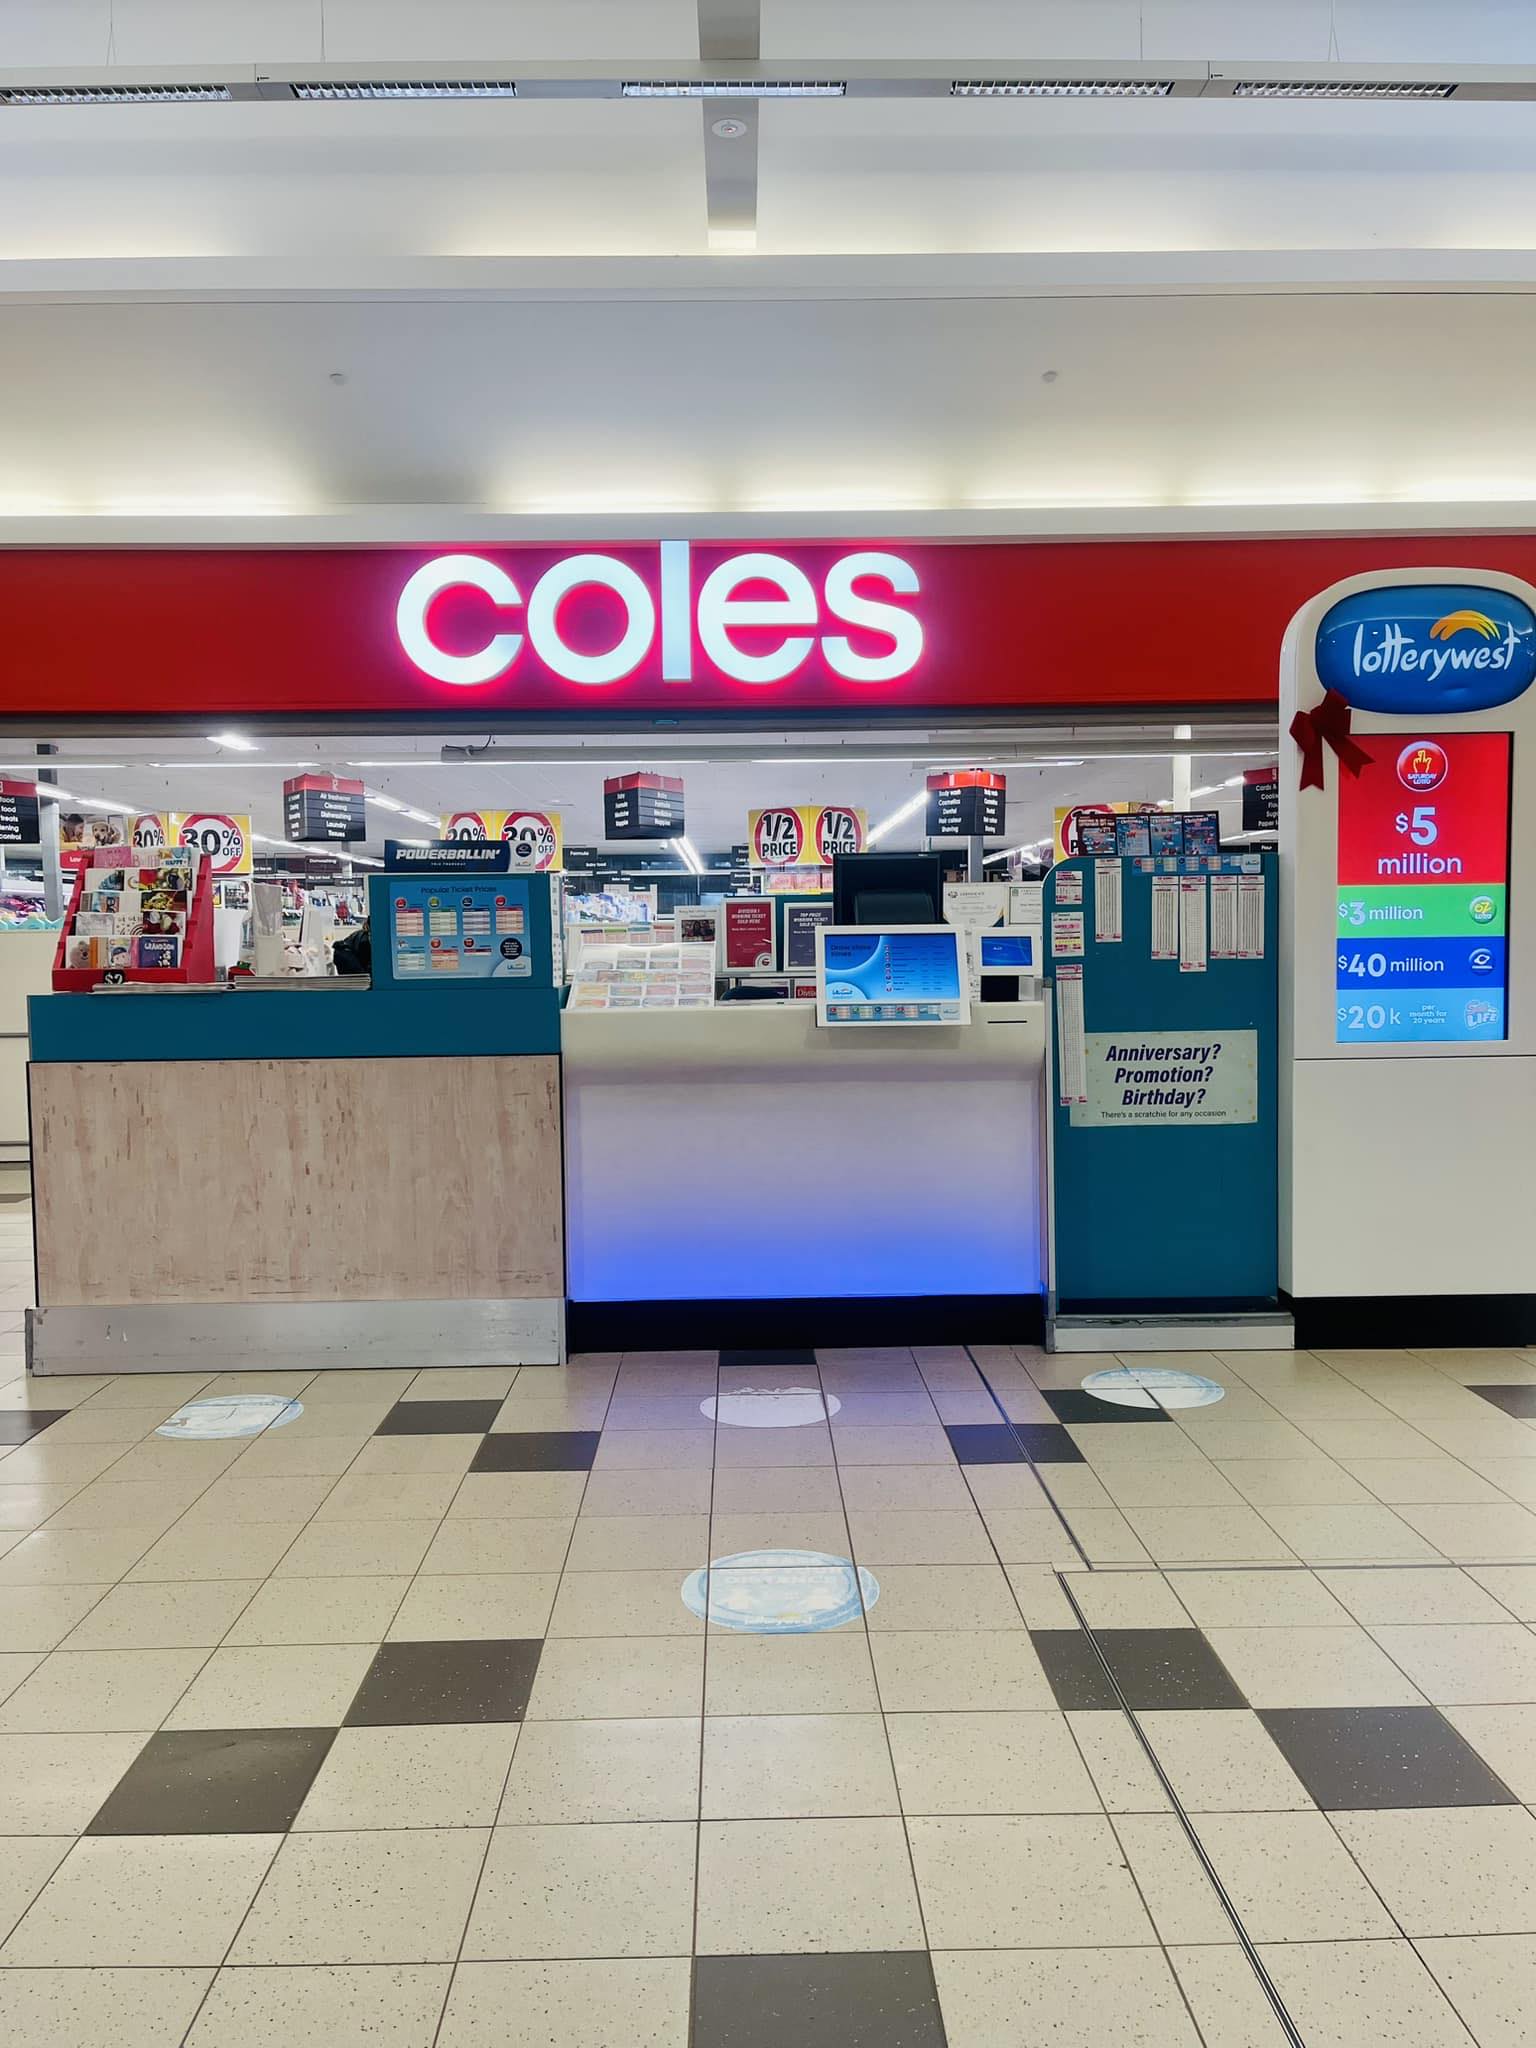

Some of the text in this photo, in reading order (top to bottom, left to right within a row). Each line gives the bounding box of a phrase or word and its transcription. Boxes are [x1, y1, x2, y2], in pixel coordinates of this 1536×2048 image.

[396, 540, 923, 685] coles
[1353, 621, 1521, 681] lotterywest
[763, 814, 794, 841] 1/2
[824, 811, 854, 839] 1/2
[1395, 806, 1438, 846] $5
[181, 827, 241, 856] 30%
[222, 847, 241, 856] OFF
[537, 844, 554, 854] OFF
[762, 841, 797, 857] PRICE
[823, 840, 856, 854] PRICE
[396, 848, 500, 860] POWERBALLIN'
[1377, 853, 1463, 874] million
[421, 886, 450, 894] Popular
[1338, 902, 1424, 926] $3 million
[1338, 953, 1444, 977] $40 million
[1337, 1005, 1400, 1029] $20 k
[1424, 1017, 1445, 1025] years
[1105, 1043, 1222, 1064] Anniversary?
[1115, 1066, 1213, 1083] Promotion?
[1122, 1088, 1206, 1108] Birthday?
